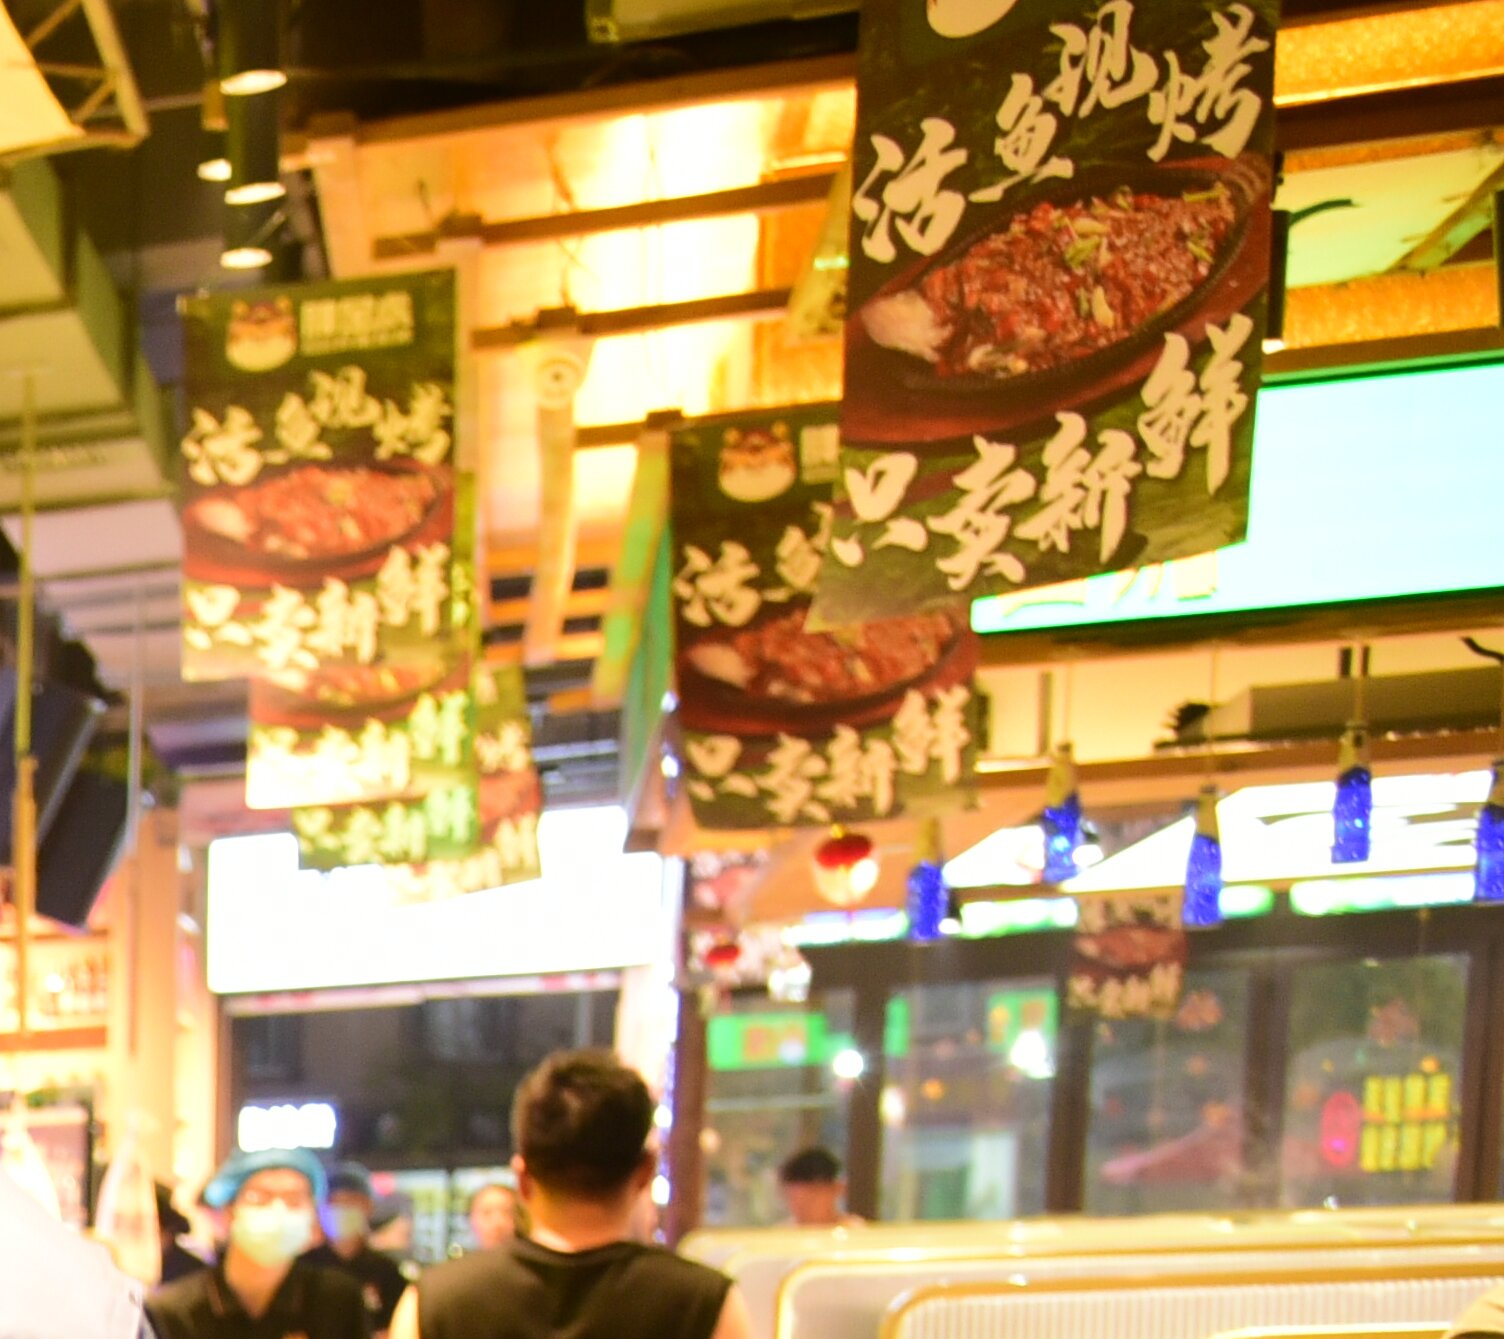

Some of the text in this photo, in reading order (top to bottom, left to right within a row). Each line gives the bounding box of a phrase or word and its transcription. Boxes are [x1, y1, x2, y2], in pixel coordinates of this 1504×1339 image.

[852, 0, 1271, 264] 活鱼现烤
[831, 312, 1254, 592] 只卖新鲜
